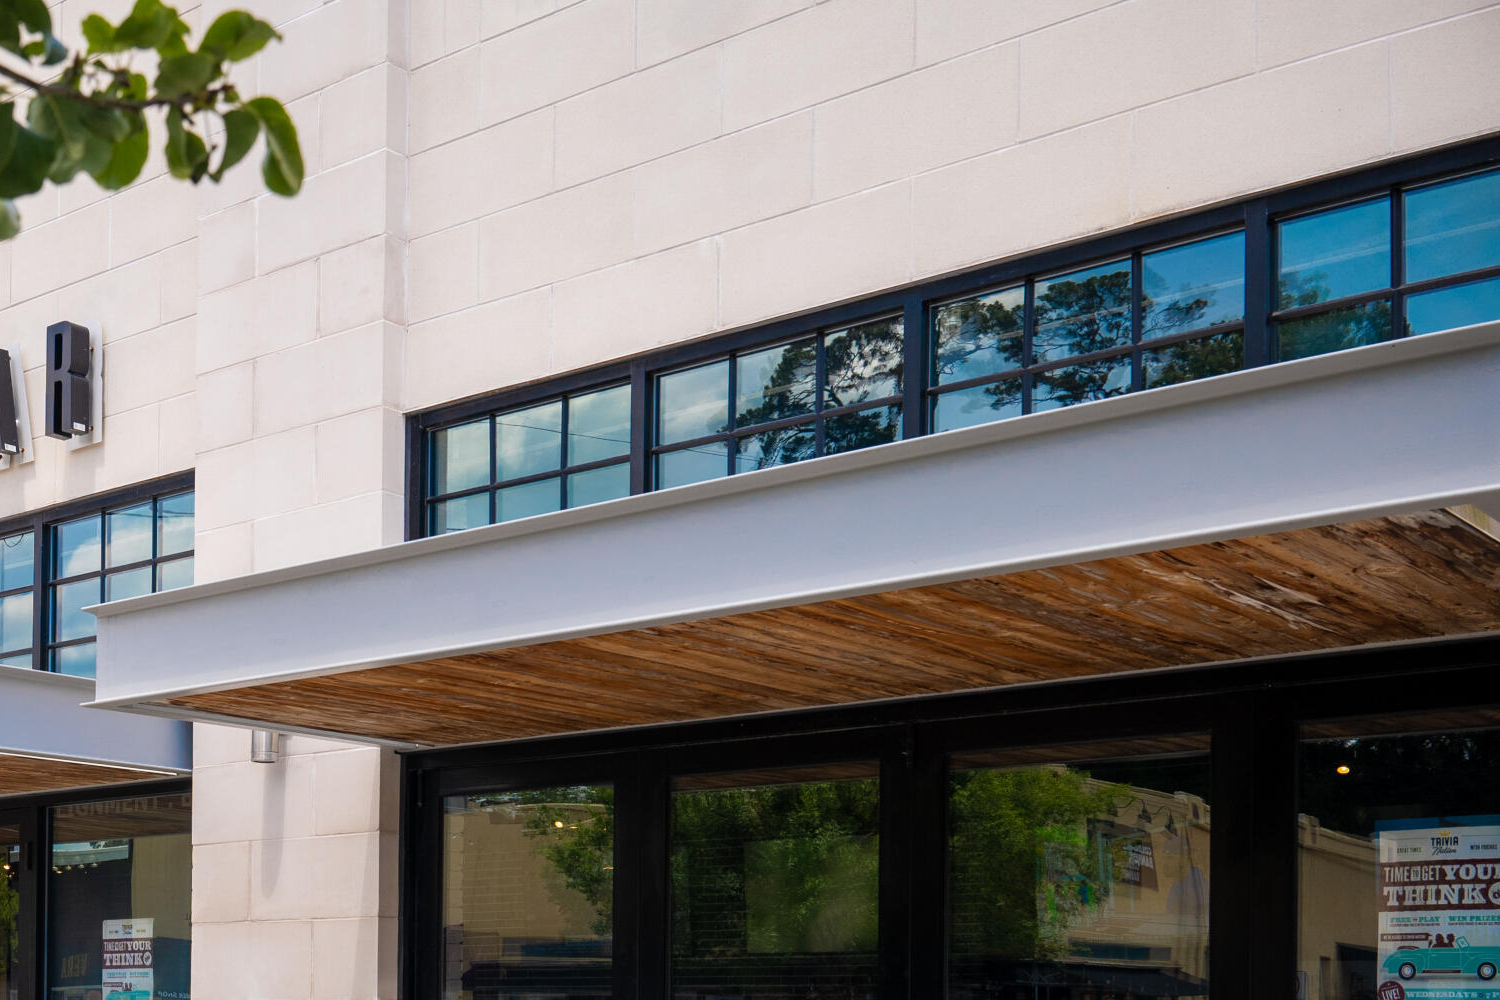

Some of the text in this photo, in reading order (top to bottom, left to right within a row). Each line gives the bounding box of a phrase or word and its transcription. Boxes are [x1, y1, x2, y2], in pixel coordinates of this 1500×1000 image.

[1430, 836, 1459, 847] TRIVIA
[1383, 866, 1410, 882] TIME
[1422, 865, 1441, 881] GET
[1383, 884, 1487, 906] THINK
[127, 940, 151, 950] YOUR
[104, 953, 143, 966] THINK
